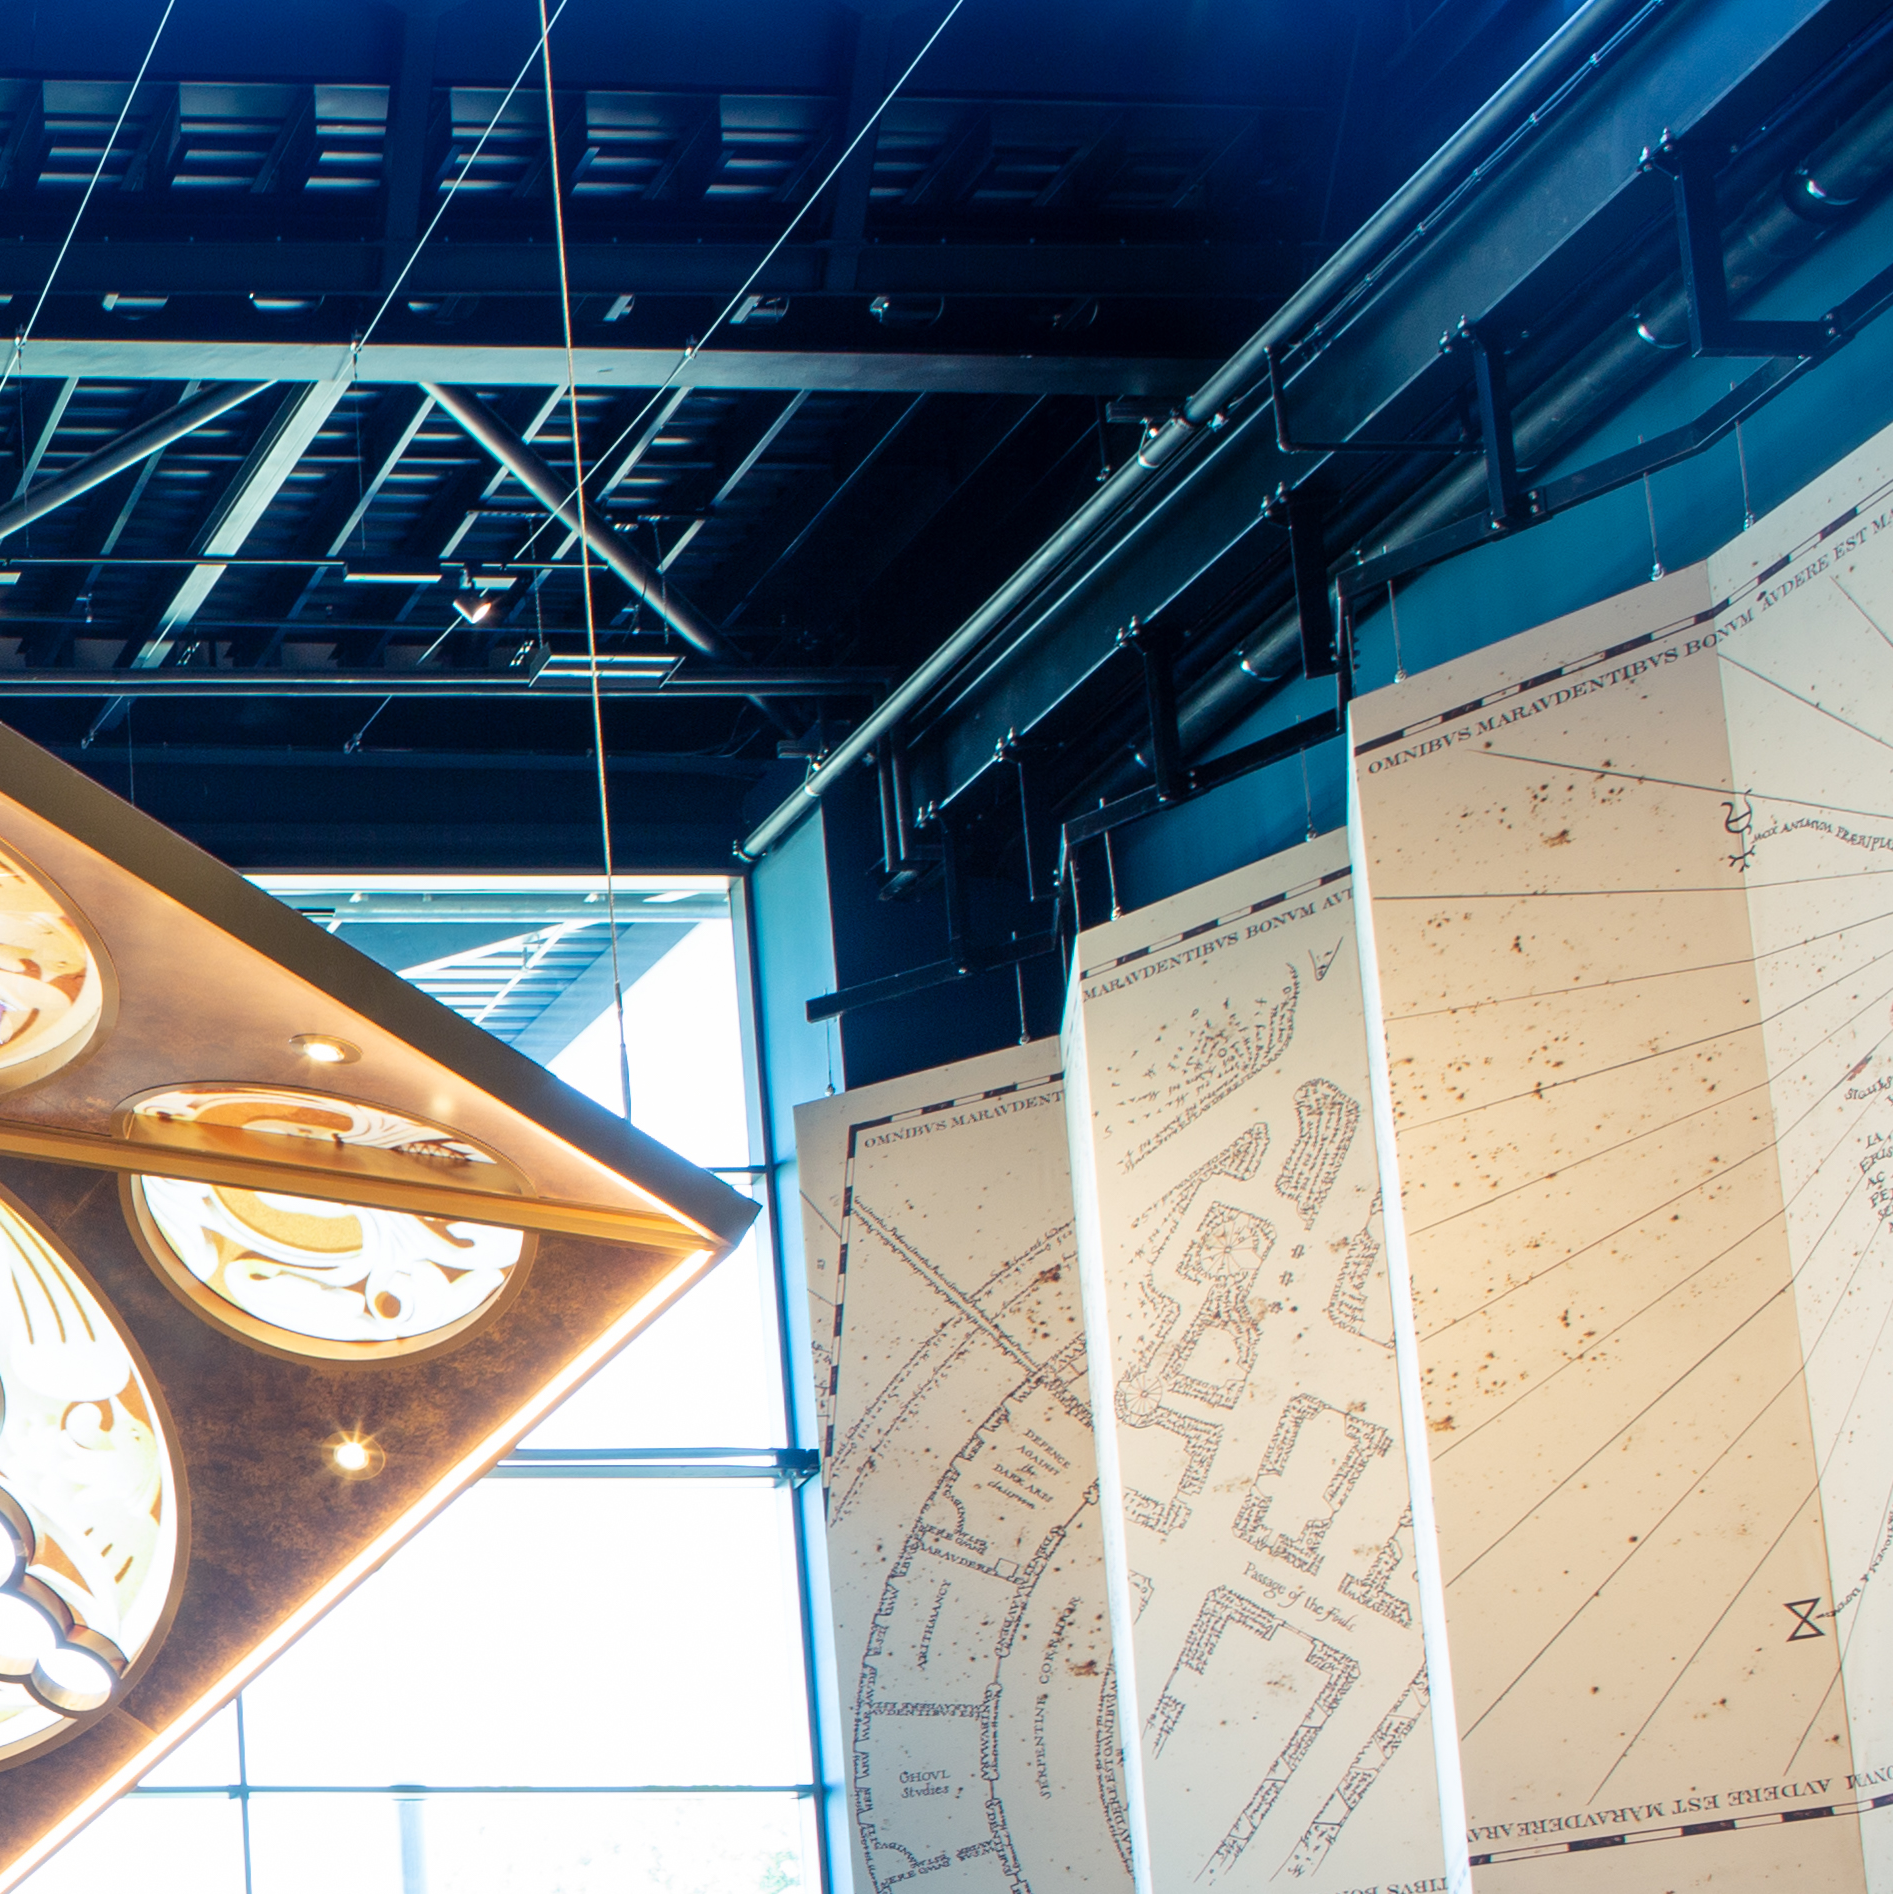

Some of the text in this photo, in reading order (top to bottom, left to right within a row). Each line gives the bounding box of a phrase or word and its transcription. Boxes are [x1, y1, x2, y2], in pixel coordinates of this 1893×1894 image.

[1368, 727, 1473, 774] OMNIBVS
[1475, 647, 1679, 737] MARAVDENTIBVS
[1683, 607, 1754, 657] BONVM
[1761, 553, 1830, 612] AVDERE
[1832, 526, 1868, 561] EST
[1082, 931, 1239, 1002] MARAVDENTIBVS
[1245, 905, 1317, 940] BONVM
[864, 1120, 947, 1149] OMNIBVS
[1016, 1445, 1060, 1476] AGAINST
[1023, 1428, 1071, 1470] DEFENCE
[992, 1463, 1025, 1487] DARK
[1242, 1560, 1287, 1599] Passage
[1304, 1596, 1324, 1615] the
[917, 1578, 951, 1672] ARITHMANCY
[1033, 1694, 1052, 1800] SERPENTINE
[1672, 1794, 1719, 1815] EST
[1727, 1778, 1832, 1806] AVDERE
